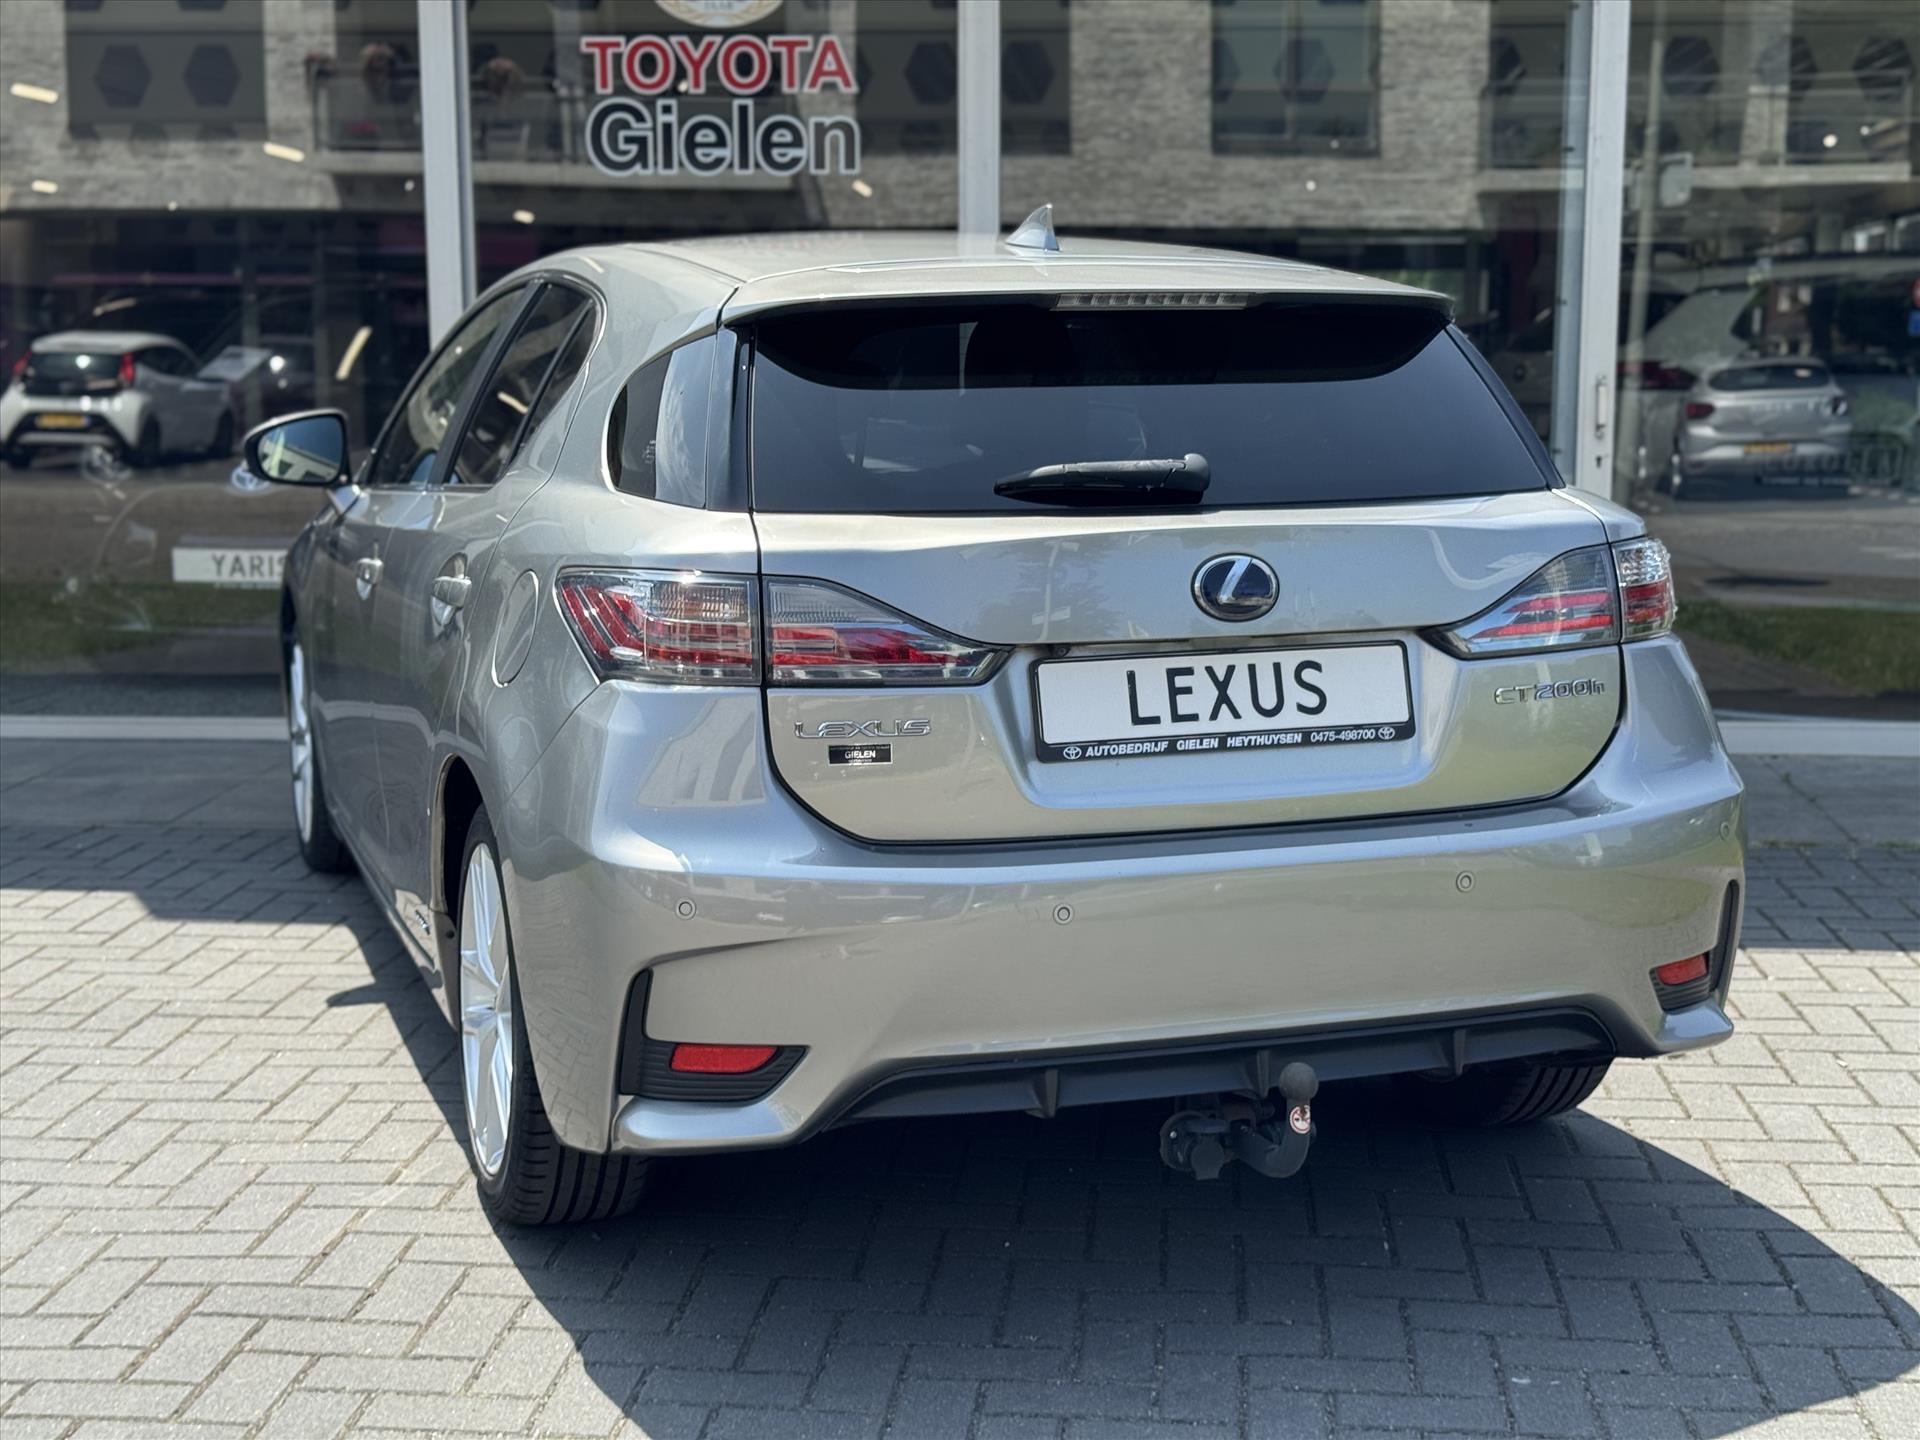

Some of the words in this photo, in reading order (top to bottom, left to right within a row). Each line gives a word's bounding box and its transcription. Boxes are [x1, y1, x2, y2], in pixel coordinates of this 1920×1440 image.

[580, 35, 859, 95] TOYOTA
[585, 97, 861, 176] Gielen
[1126, 659, 1327, 726] LEXUS
[1494, 678, 1606, 704] CT200h
[794, 718, 932, 739] LEXUS
[1085, 740, 1169, 757] AUTOBEDRIJF
[1176, 737, 1219, 752] GIELEN
[1226, 732, 1302, 748] HEYTHUYSEN
[1310, 728, 1376, 743] 0475-498700
[844, 750, 876, 759] GIELEN
